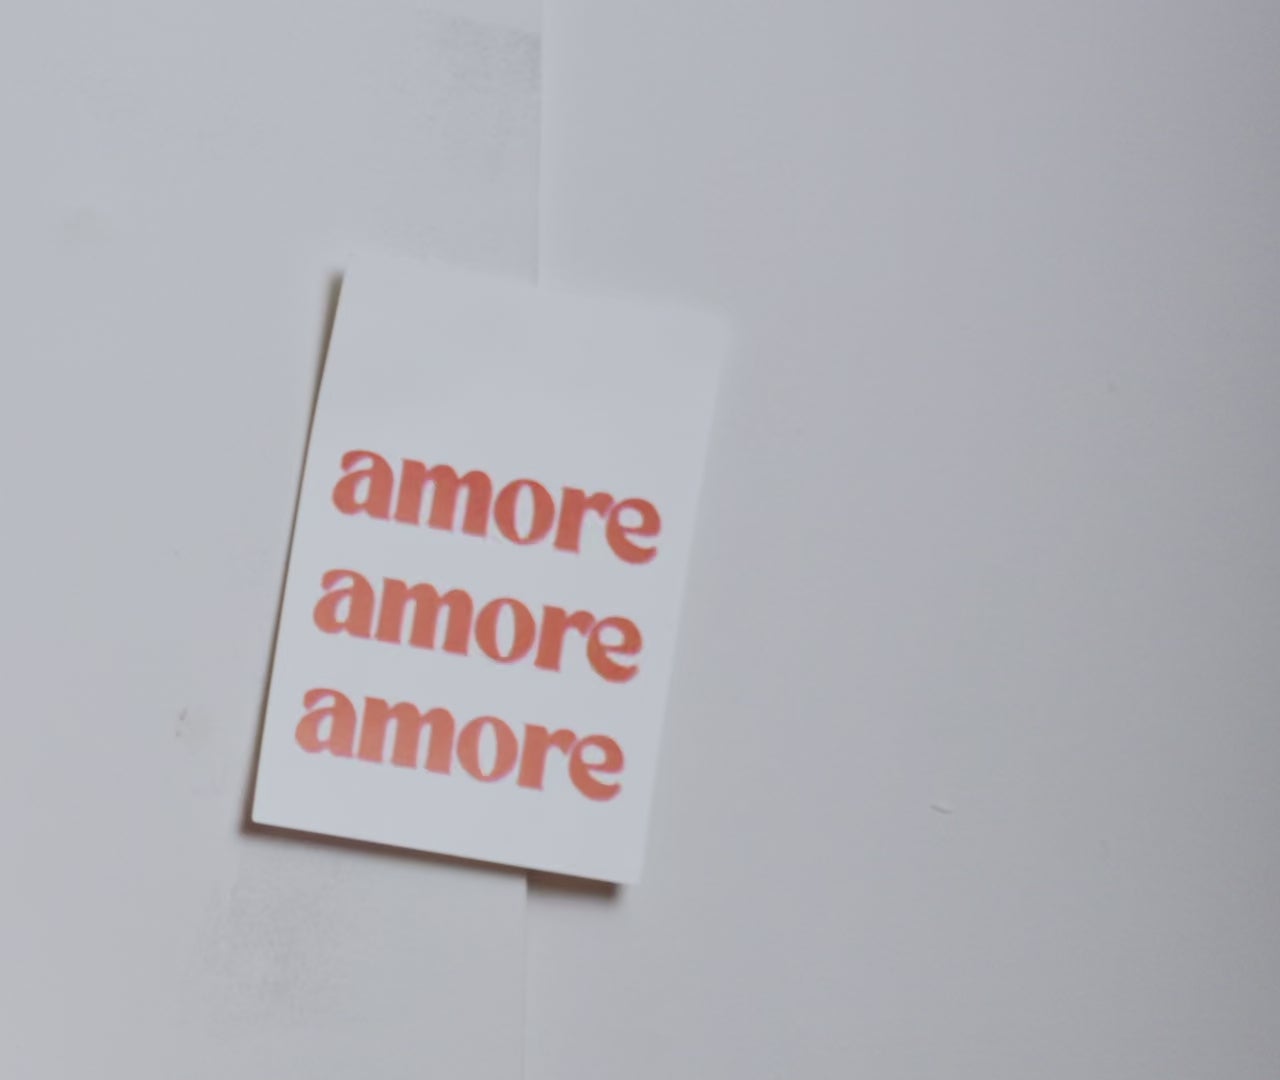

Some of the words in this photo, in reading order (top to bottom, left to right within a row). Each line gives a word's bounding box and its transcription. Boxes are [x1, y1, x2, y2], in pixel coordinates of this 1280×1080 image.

[332, 448, 662, 564] amore
[313, 568, 644, 683] amore
[295, 686, 625, 802] amore
